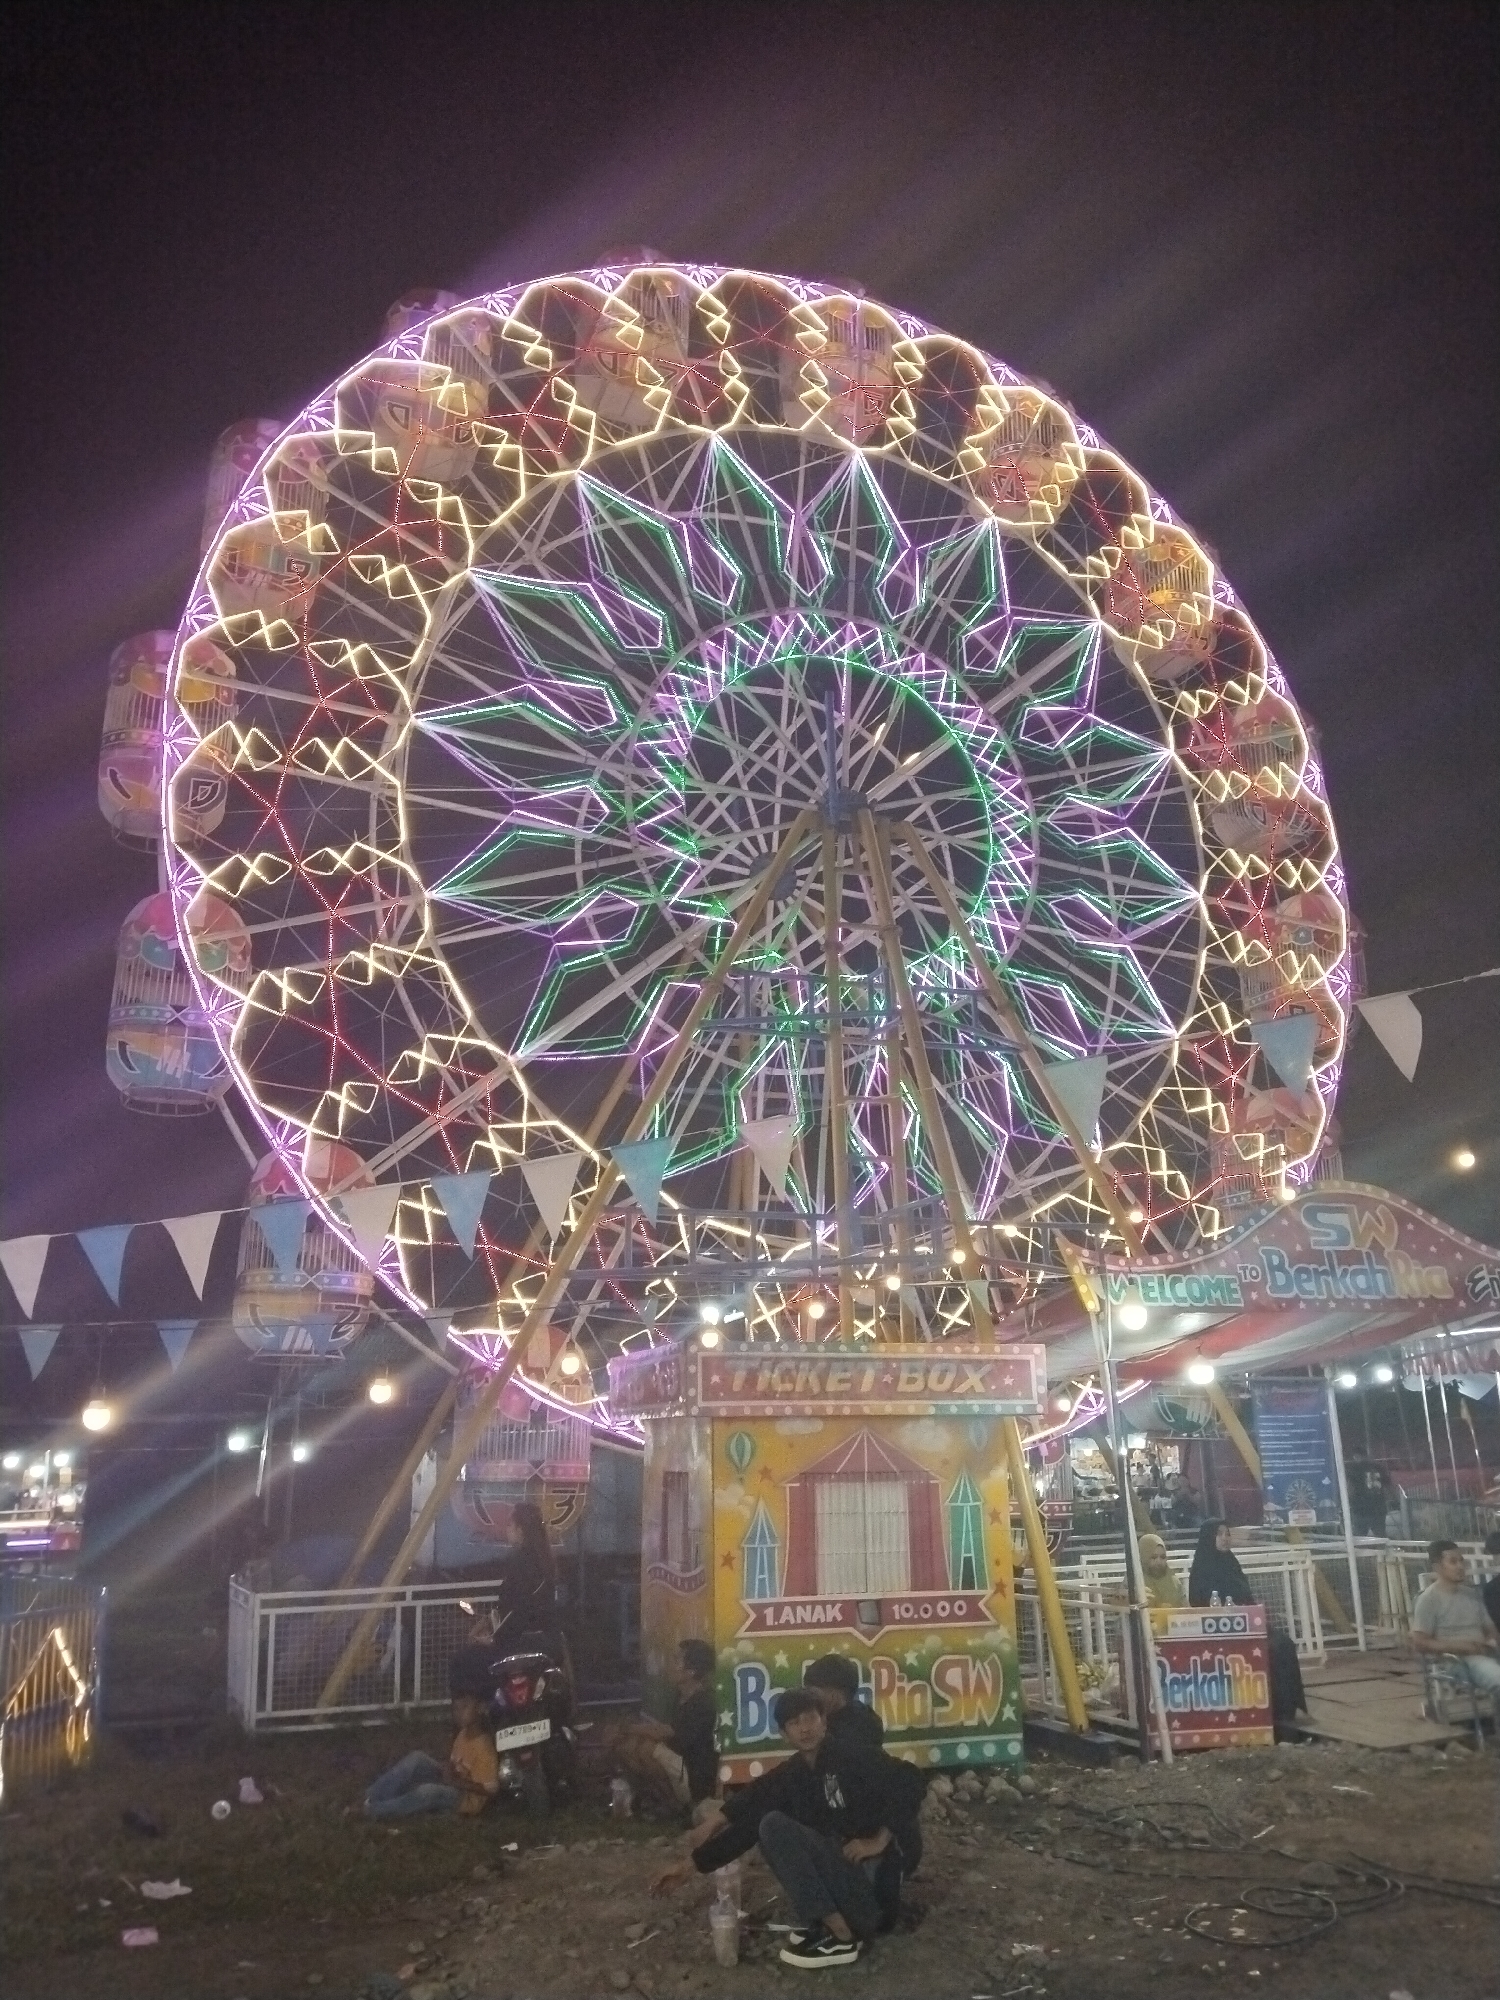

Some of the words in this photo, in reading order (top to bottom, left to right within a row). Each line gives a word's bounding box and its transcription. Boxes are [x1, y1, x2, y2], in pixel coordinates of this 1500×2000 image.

[1301, 1202, 1399, 1251] SW
[1107, 1272, 1244, 1307] WELCOME
[1237, 1264, 1262, 1283] TO
[725, 1358, 884, 1394] TICKET
[897, 1359, 994, 1394] BOX
